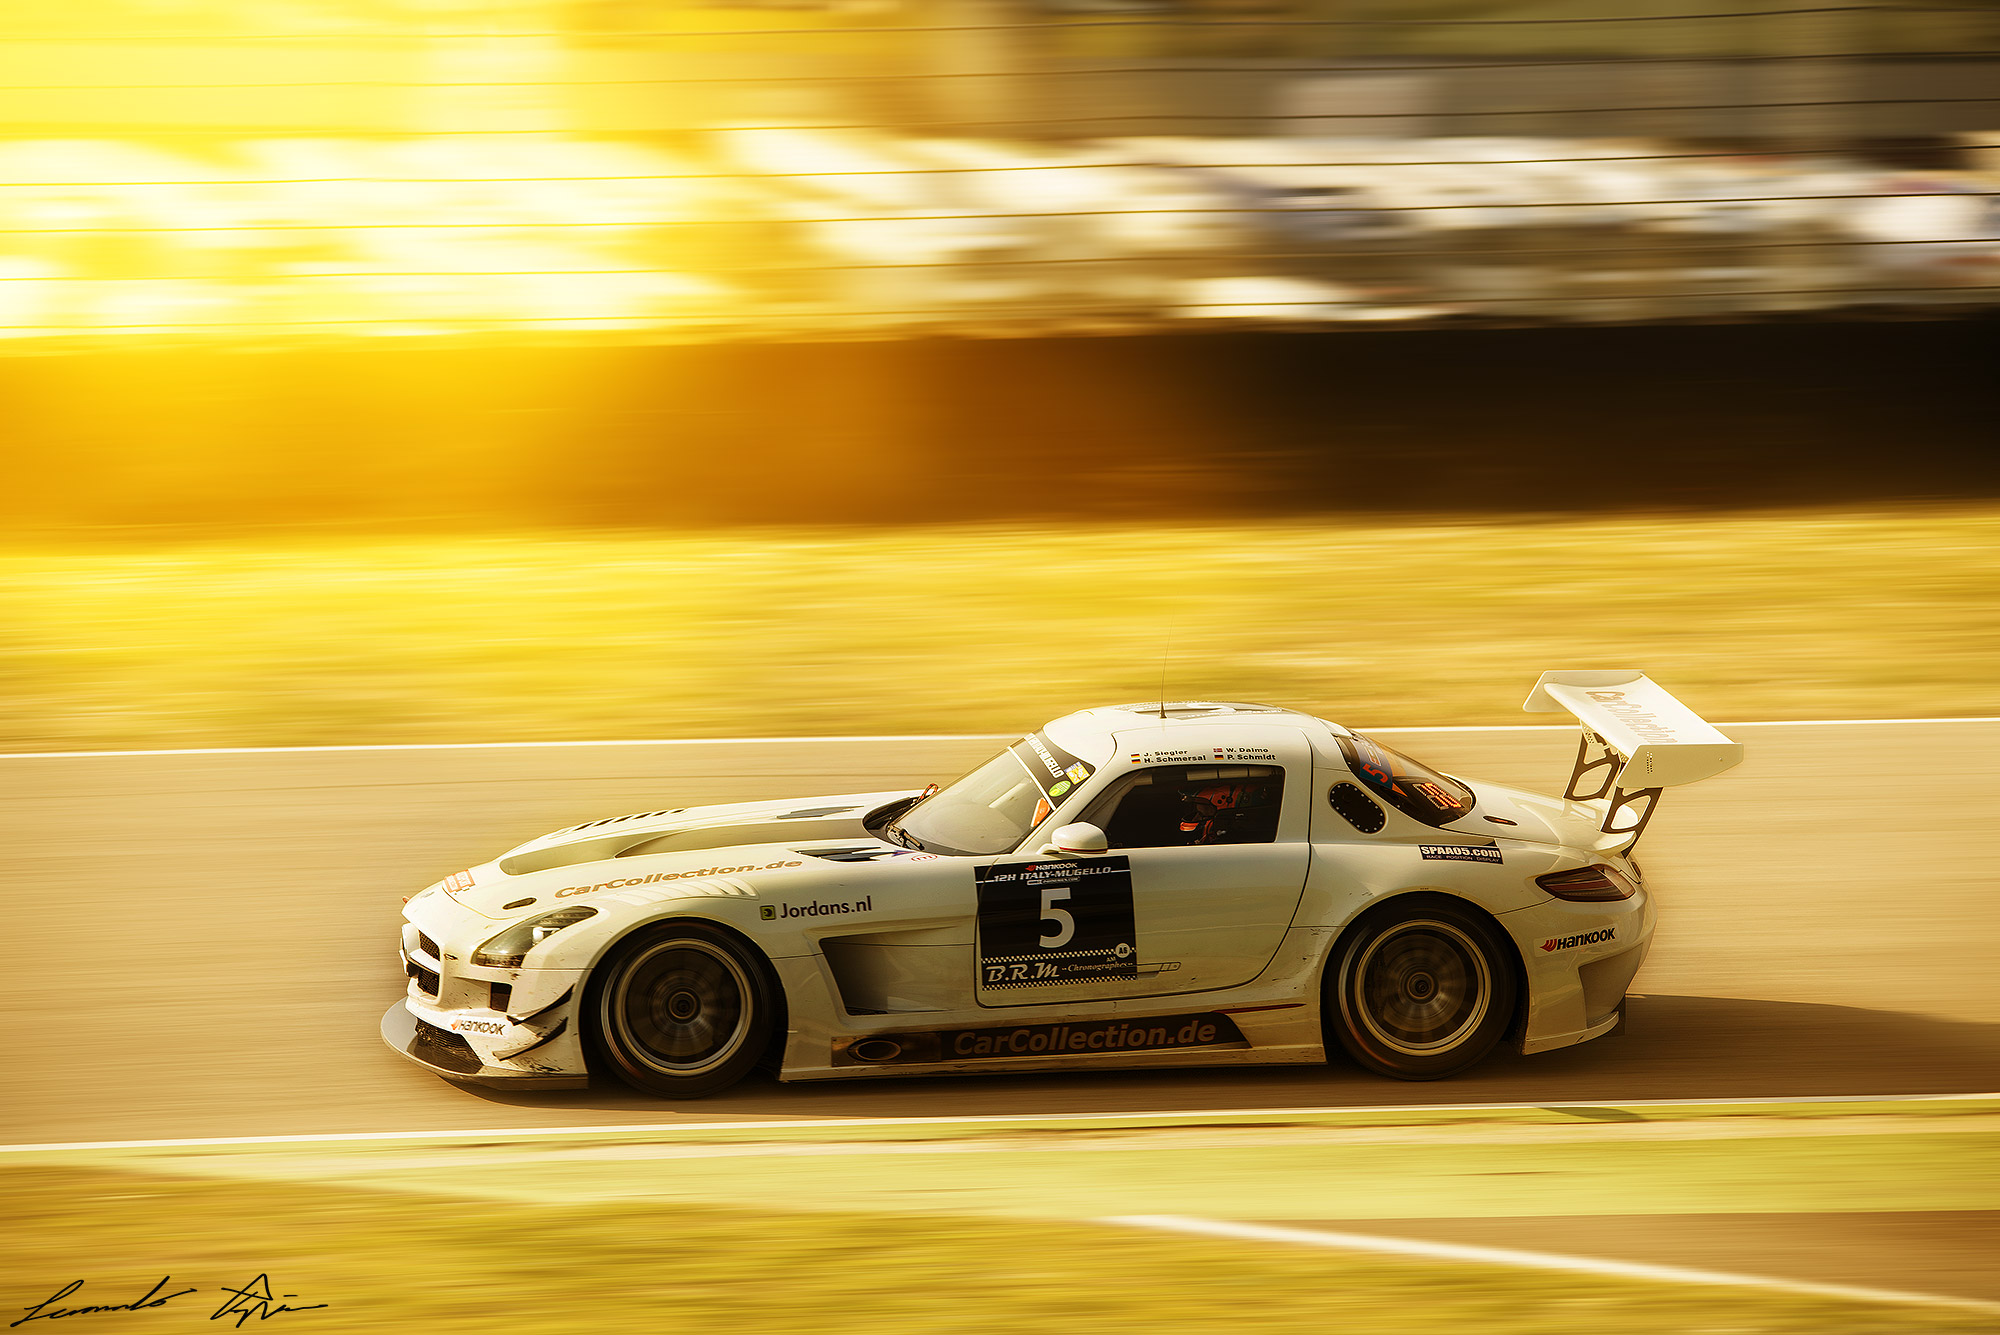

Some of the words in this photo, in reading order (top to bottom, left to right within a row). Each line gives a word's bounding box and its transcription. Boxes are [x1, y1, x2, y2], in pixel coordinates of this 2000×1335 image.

[1156, 755, 1206, 763] Schmersal
[1362, 763, 1388, 783] 5
[1421, 846, 1501, 858] SPAA05.com
[555, 860, 802, 898] CarCollection.de
[993, 873, 1017, 882] 12H
[1020, 867, 1111, 880] ITALY-MUGELLO
[780, 896, 872, 918] Jordans.nl
[1039, 887, 1075, 948] 5
[954, 1020, 1217, 1056] CarCollection.de
